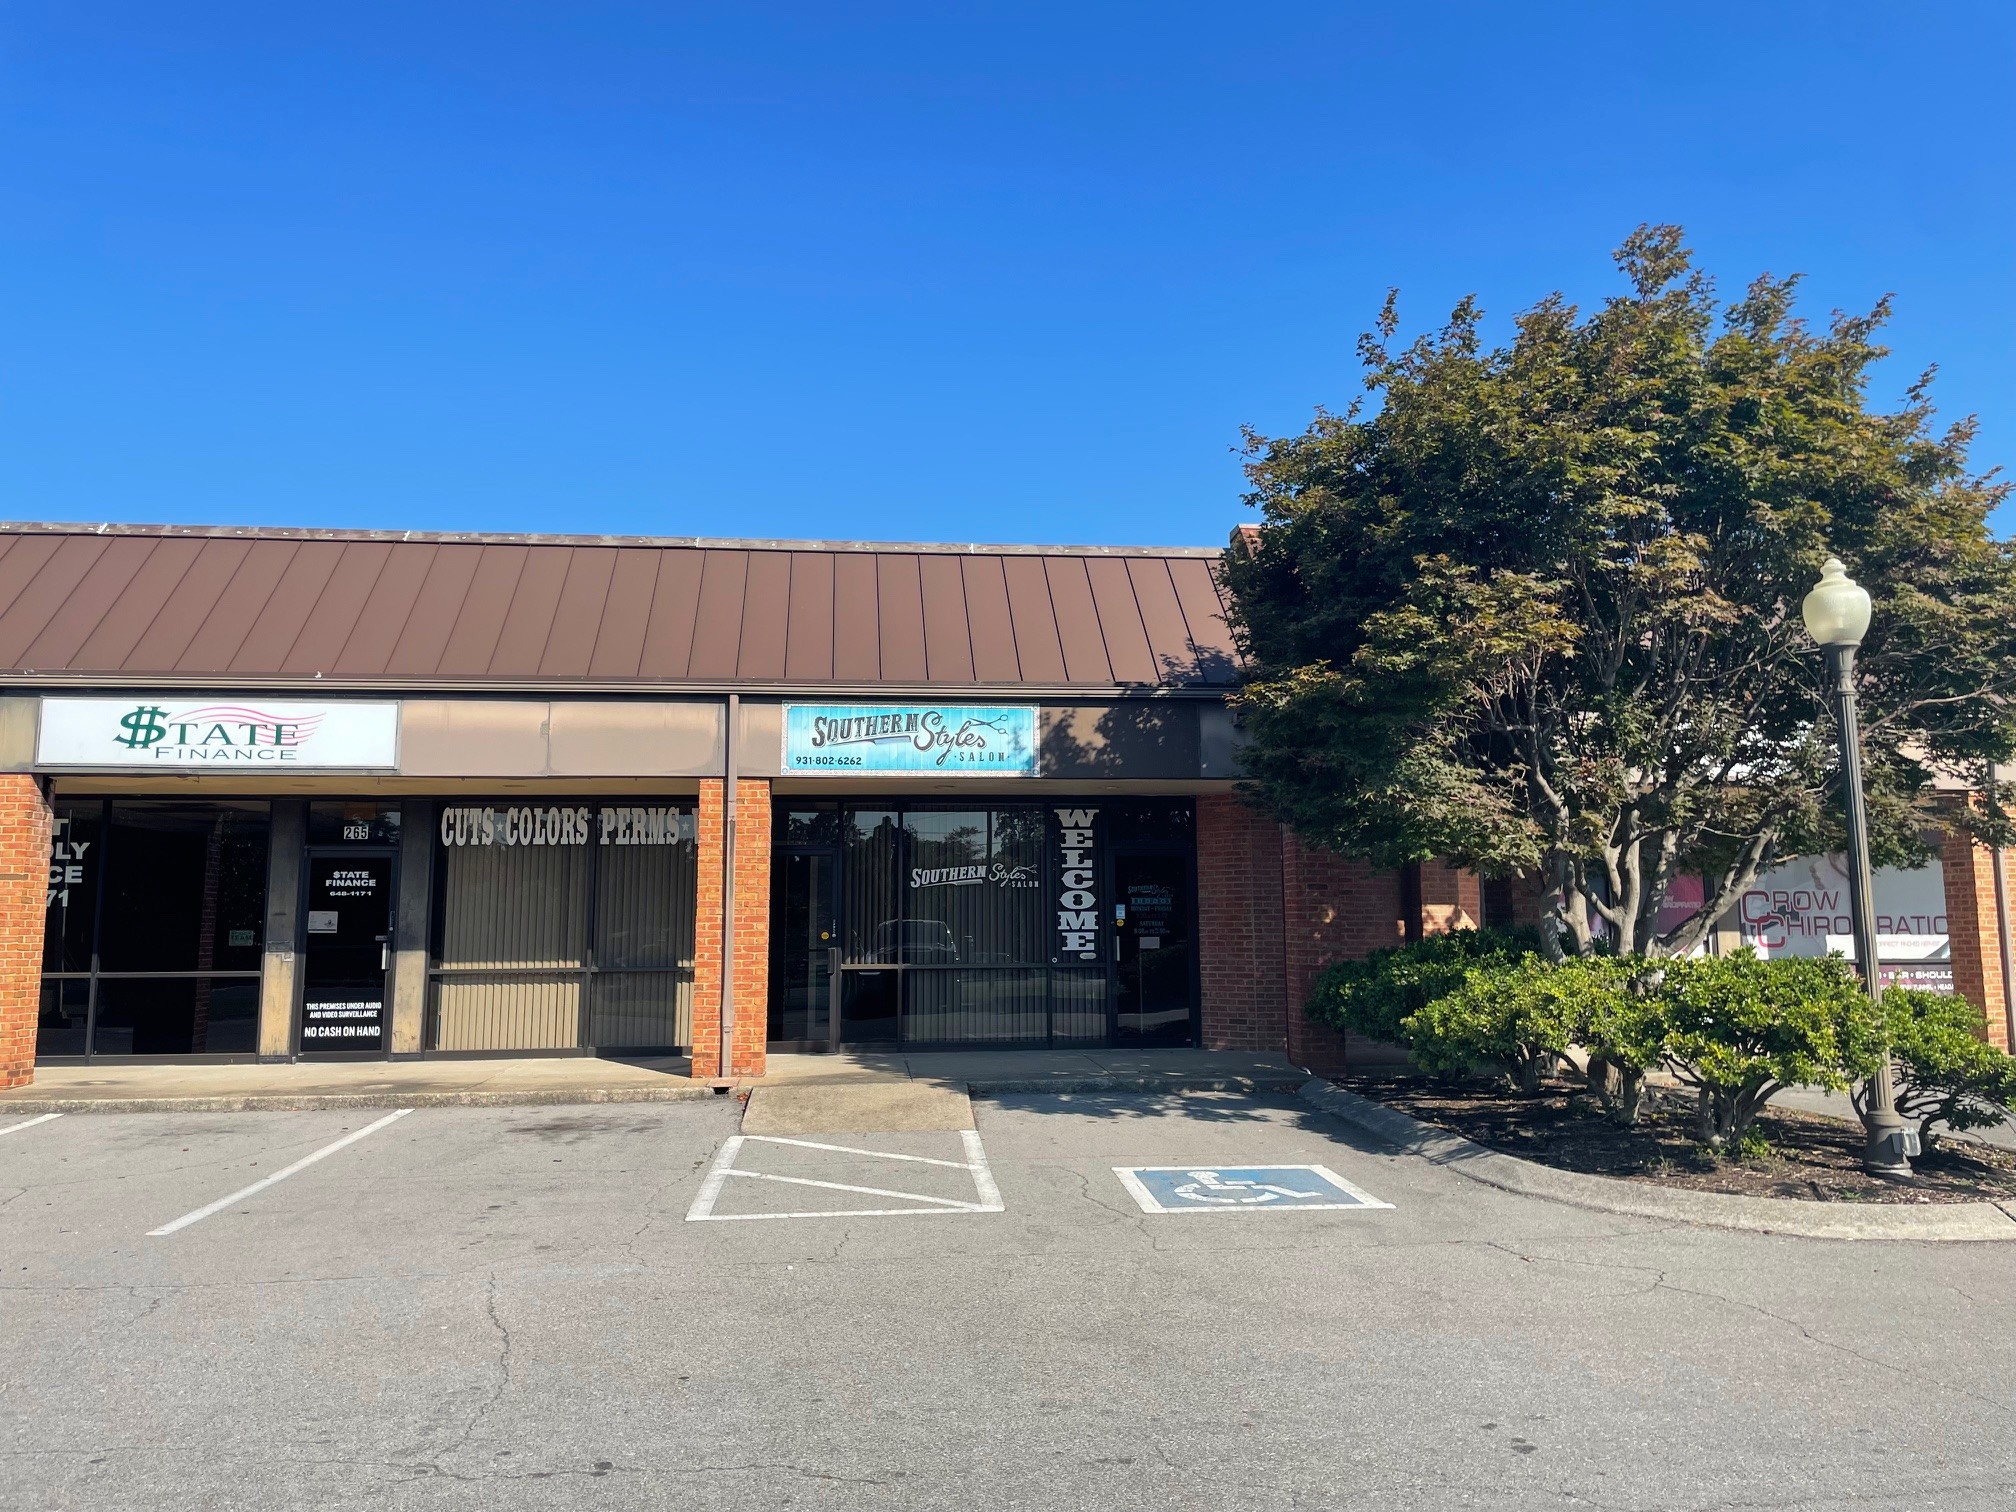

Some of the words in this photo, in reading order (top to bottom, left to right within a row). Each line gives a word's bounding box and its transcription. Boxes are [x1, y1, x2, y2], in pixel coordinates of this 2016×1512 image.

[812, 713, 919, 748] SOUTHERN
[914, 710, 986, 766] Styles
[155, 747, 297, 760] FINANCE
[959, 751, 1005, 762] SALON
[345, 827, 367, 839] 265
[441, 807, 494, 846] CUTS
[506, 807, 588, 846] COLORS
[600, 807, 679, 846] PERMS
[325, 879, 376, 887] FINANCE
[910, 866, 987, 888] SOUTHERN
[989, 863, 1027, 888] Styles
[1054, 809, 1099, 951] WELCOME
[1742, 890, 1840, 923] CROW
[304, 1027, 317, 1037] NO
[318, 1026, 342, 1037] CASH
[343, 1026, 355, 1036] ON
[356, 1026, 381, 1036] HAND
